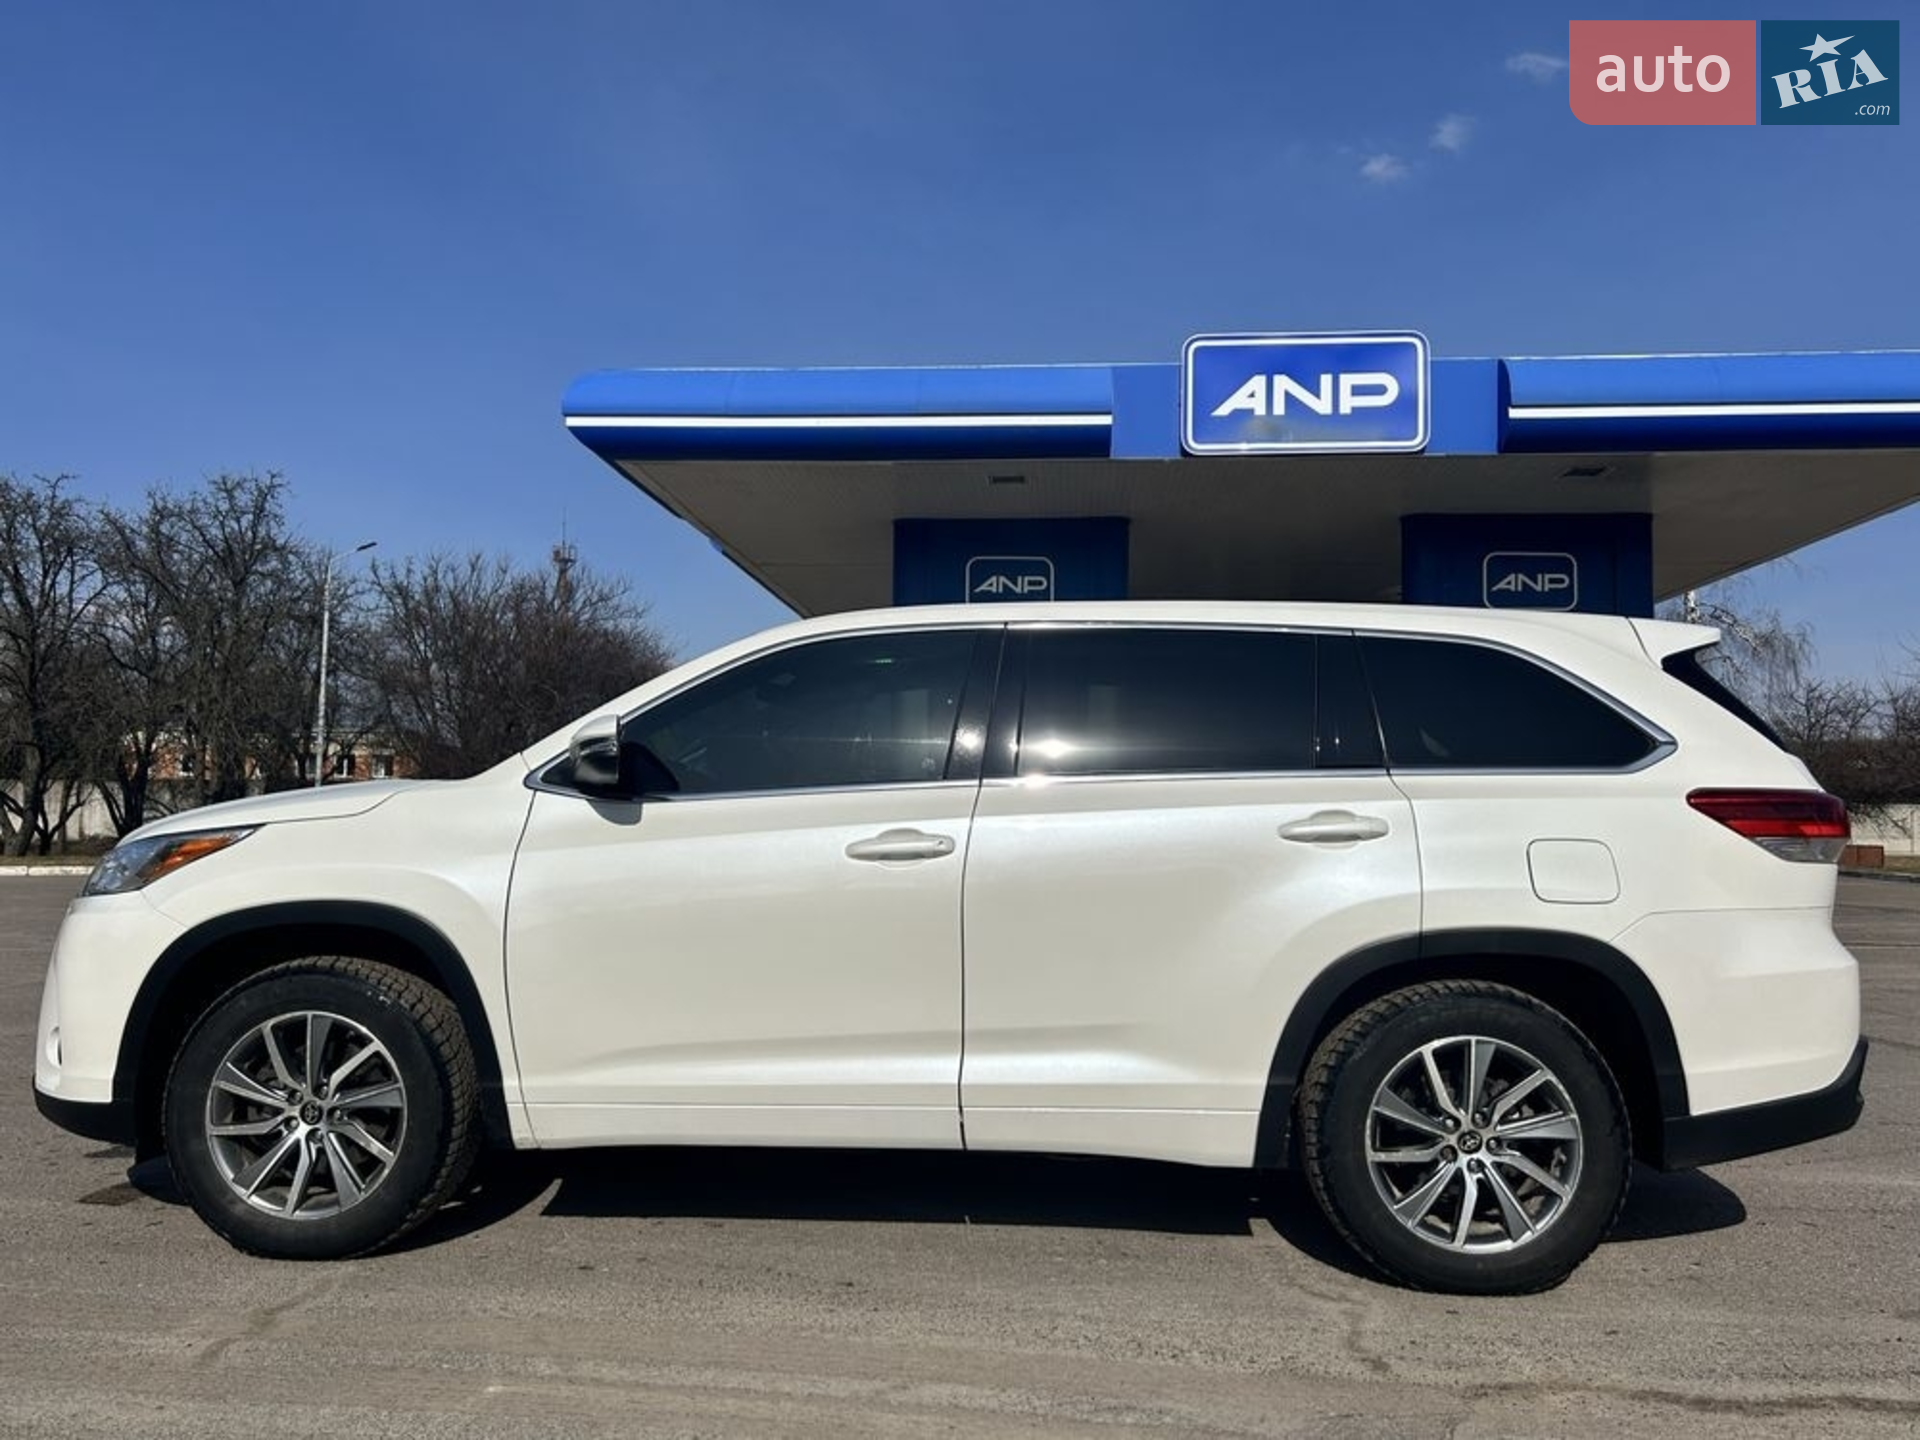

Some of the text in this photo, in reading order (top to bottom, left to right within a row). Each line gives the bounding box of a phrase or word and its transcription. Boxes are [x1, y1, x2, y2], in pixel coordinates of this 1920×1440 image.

[1210, 372, 1400, 416] ANP
[973, 575, 1047, 594] ANP
[1491, 573, 1570, 592] ANP
